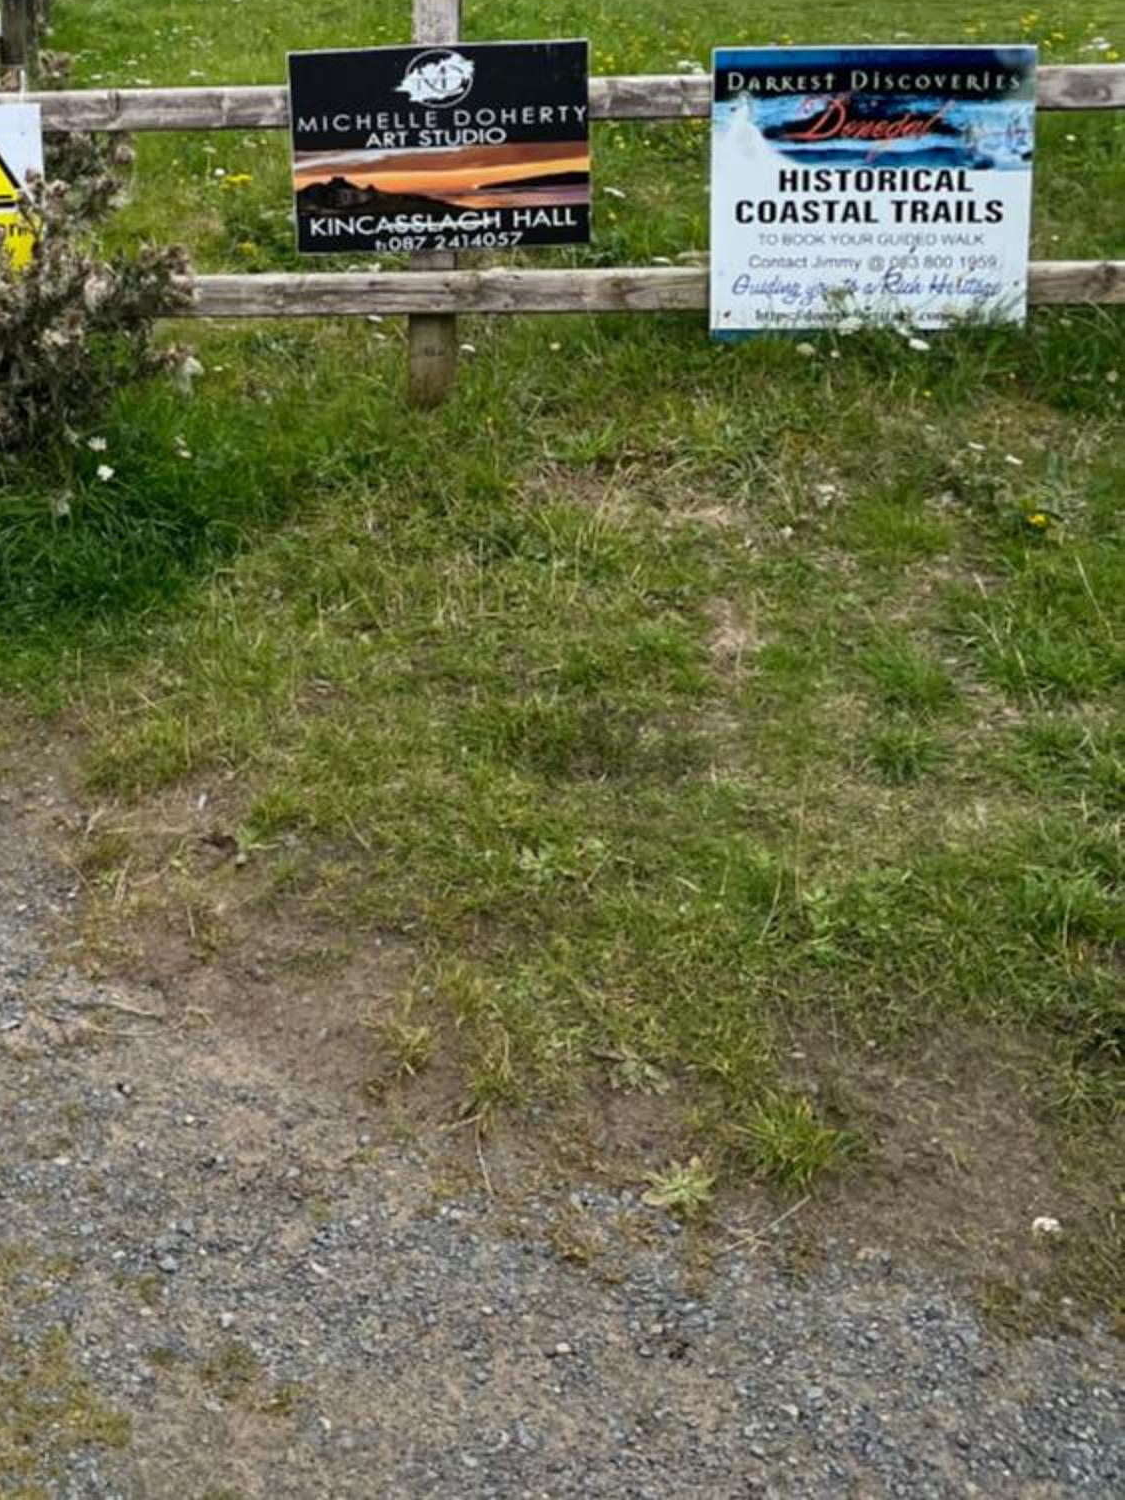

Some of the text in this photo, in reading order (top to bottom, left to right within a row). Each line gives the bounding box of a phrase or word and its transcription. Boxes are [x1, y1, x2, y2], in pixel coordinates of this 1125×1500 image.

[298, 105, 588, 132] MICHELLE DOHERTY
[365, 127, 507, 148] ART STUDIO
[778, 169, 974, 193] HISTORICAL
[309, 207, 577, 237] KINCASSLAGH HALL
[734, 200, 1005, 224] COASTAL TRAILS
[435, 231, 524, 250] 2414057
[758, 233, 985, 246] TO BOOK YOUR GUIDED WALK
[748, 254, 809, 269] Contact
[811, 255, 861, 273] Jimmy
